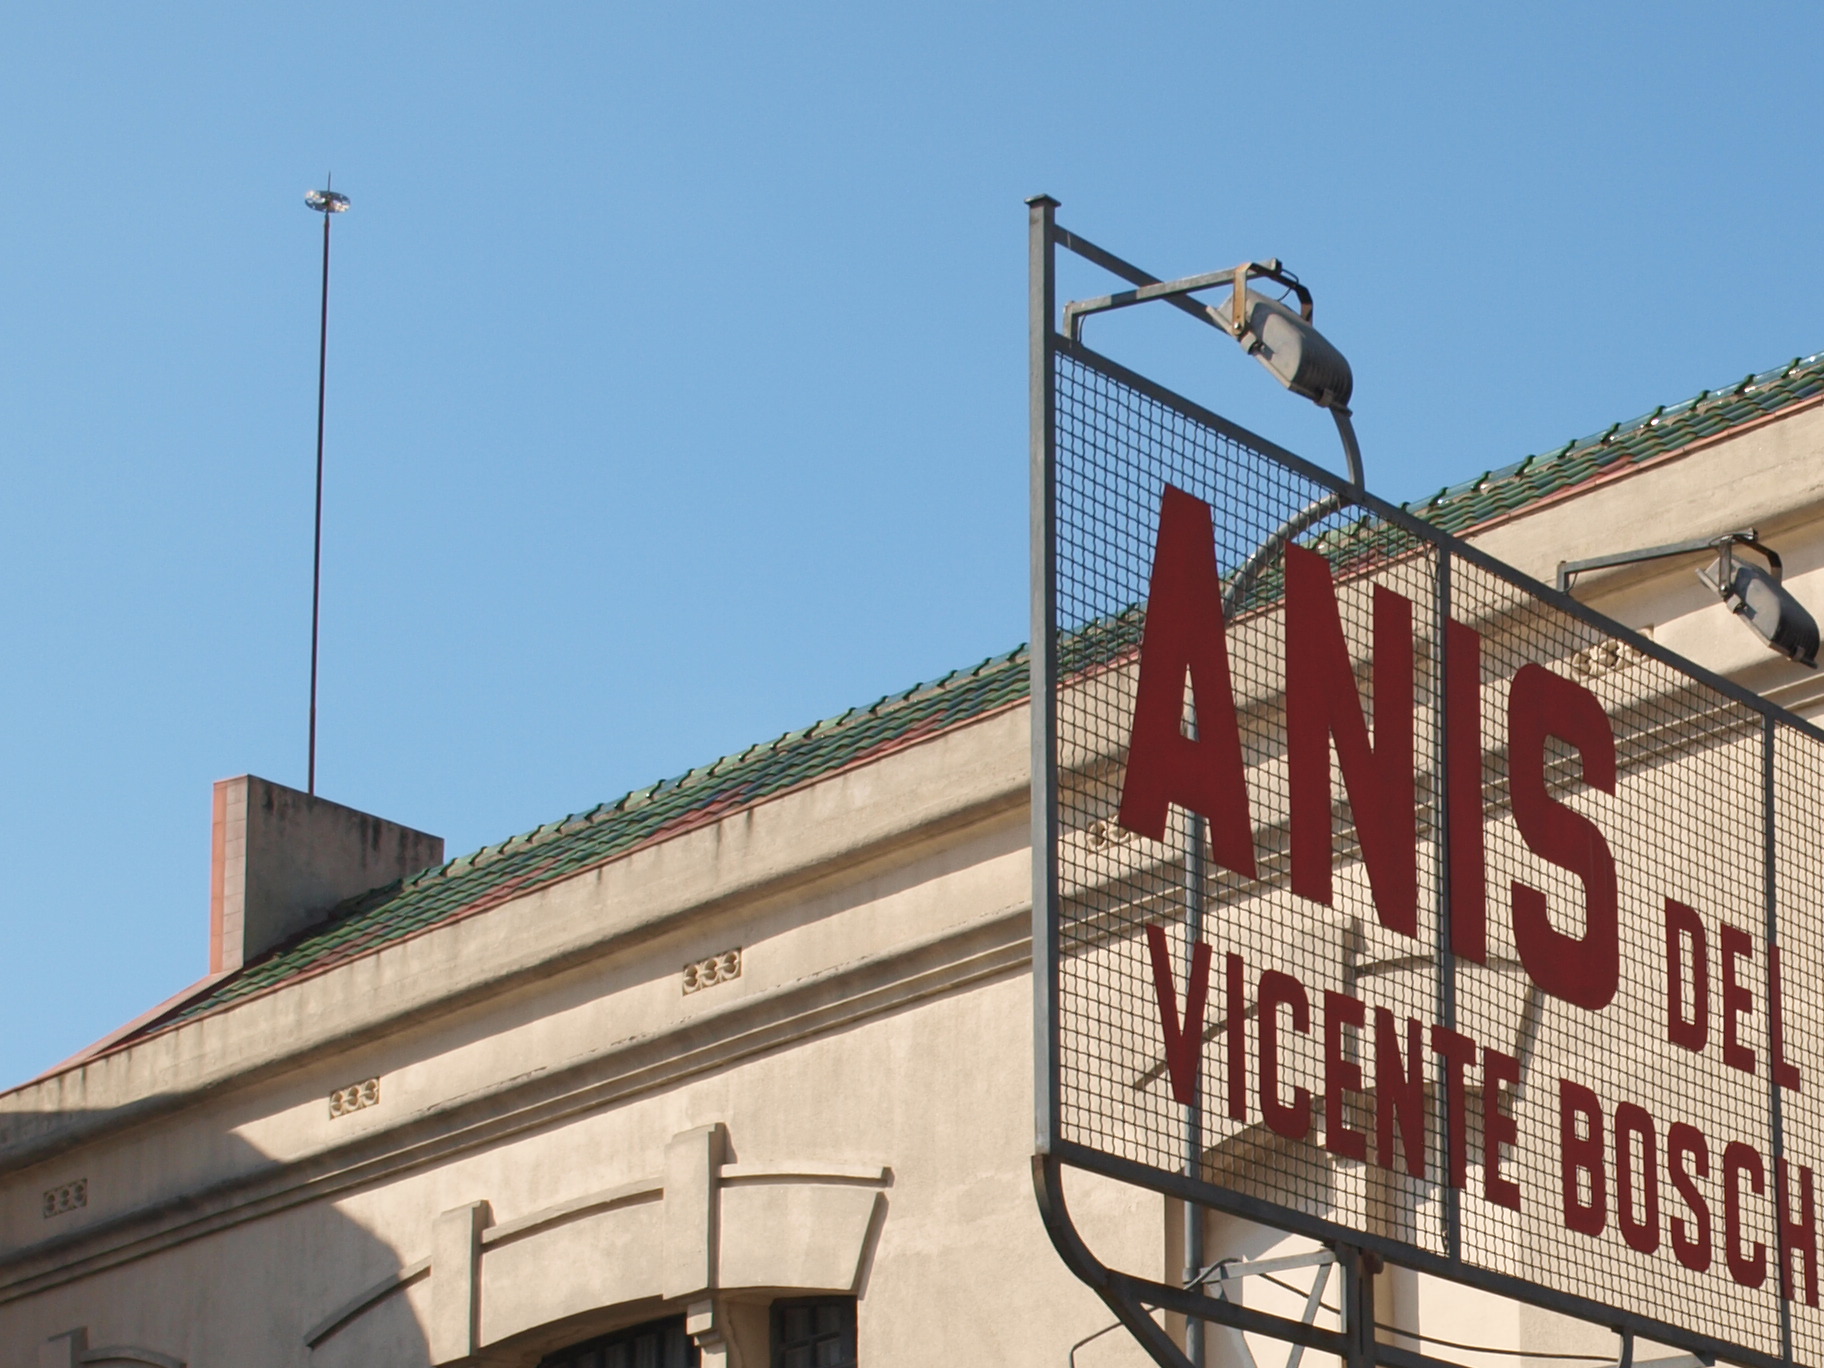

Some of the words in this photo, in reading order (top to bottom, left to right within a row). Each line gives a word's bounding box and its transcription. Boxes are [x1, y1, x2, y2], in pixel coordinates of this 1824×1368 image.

[1118, 482, 1620, 1012] ANIS
[1664, 896, 1801, 1093] DEL
[1145, 922, 1521, 1212] VICENTE
[1558, 1077, 1820, 1308] BOSCH
